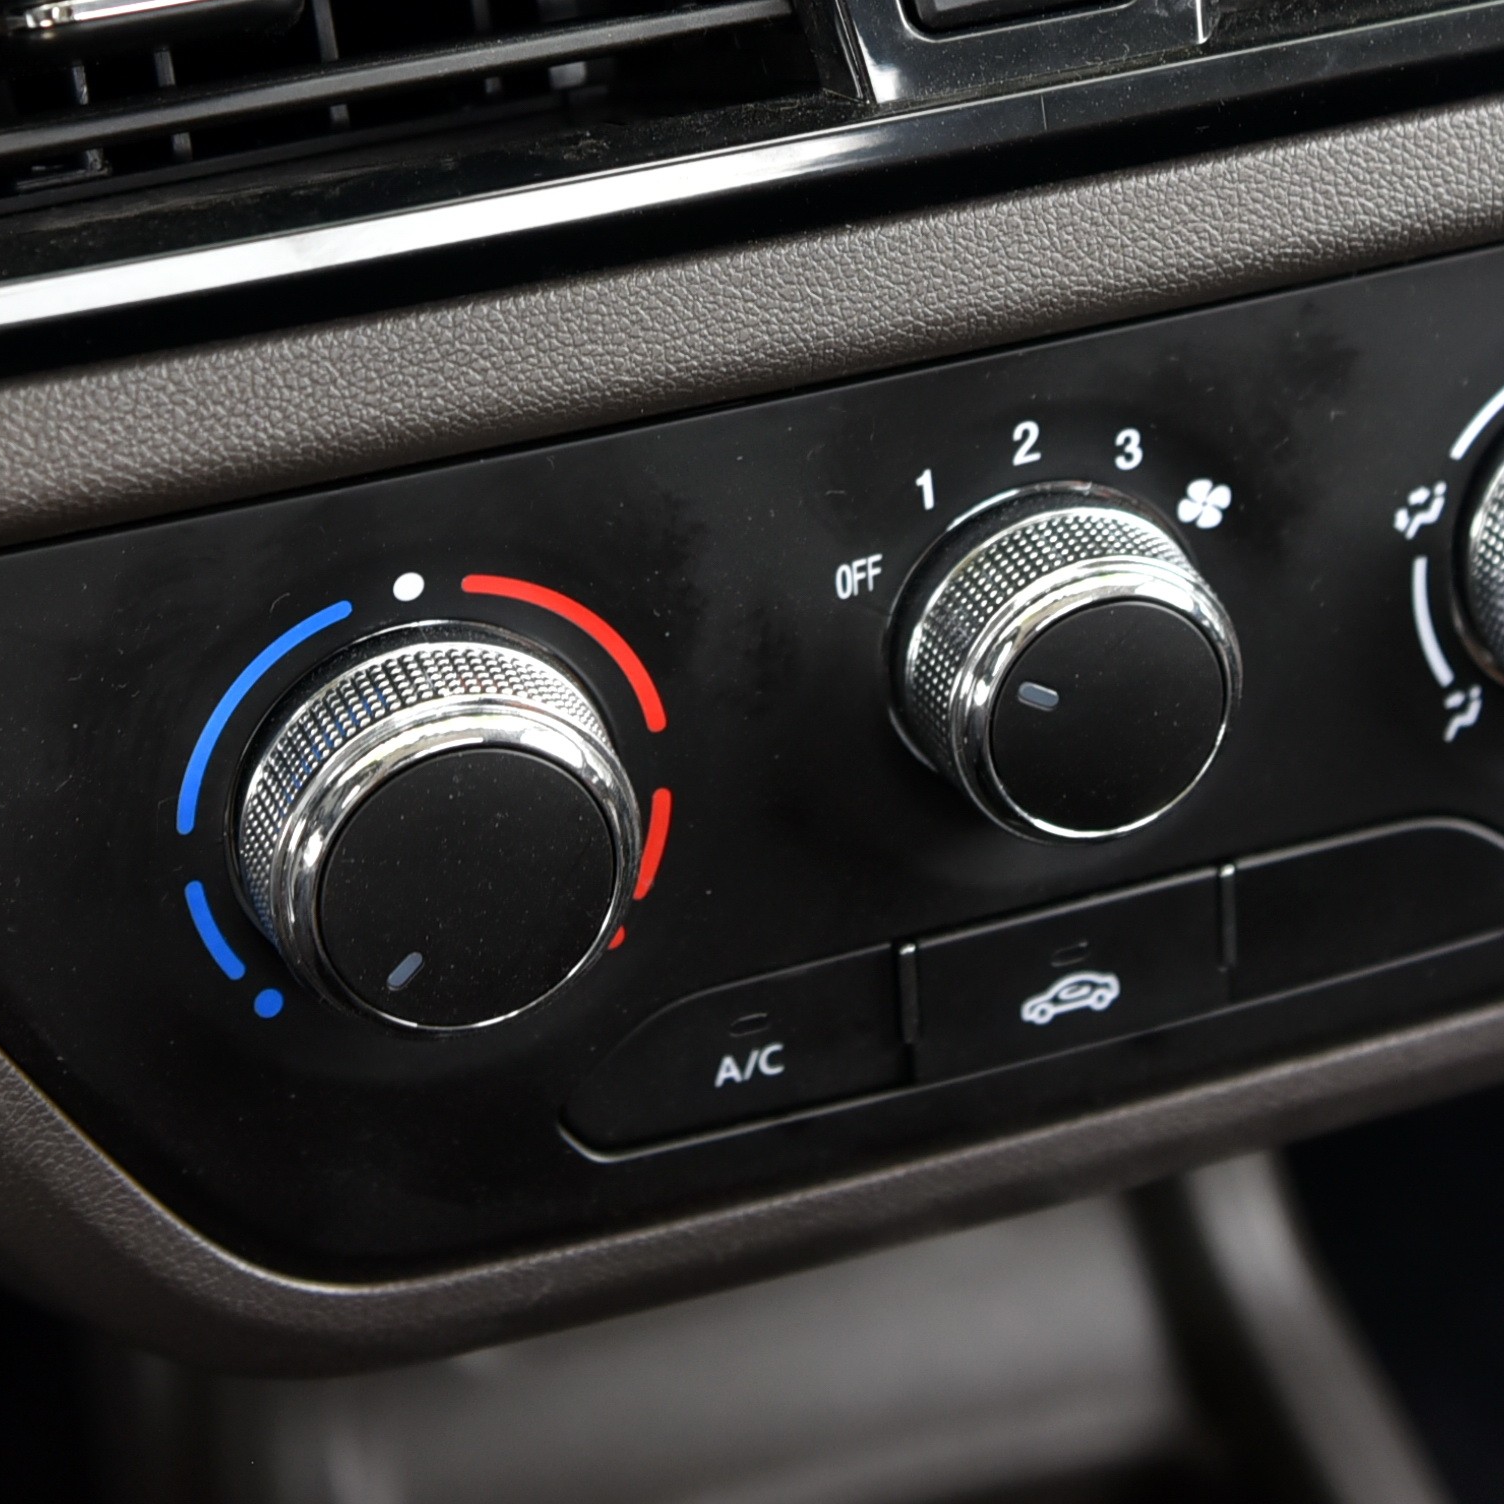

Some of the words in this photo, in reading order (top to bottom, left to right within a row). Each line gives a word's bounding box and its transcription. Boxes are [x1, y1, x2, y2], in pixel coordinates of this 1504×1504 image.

[1012, 420, 1041, 466] 2
[1114, 428, 1143, 470] 3
[915, 468, 935, 510] 1
[834, 553, 883, 600] OFF
[714, 1042, 785, 1087] A/C
